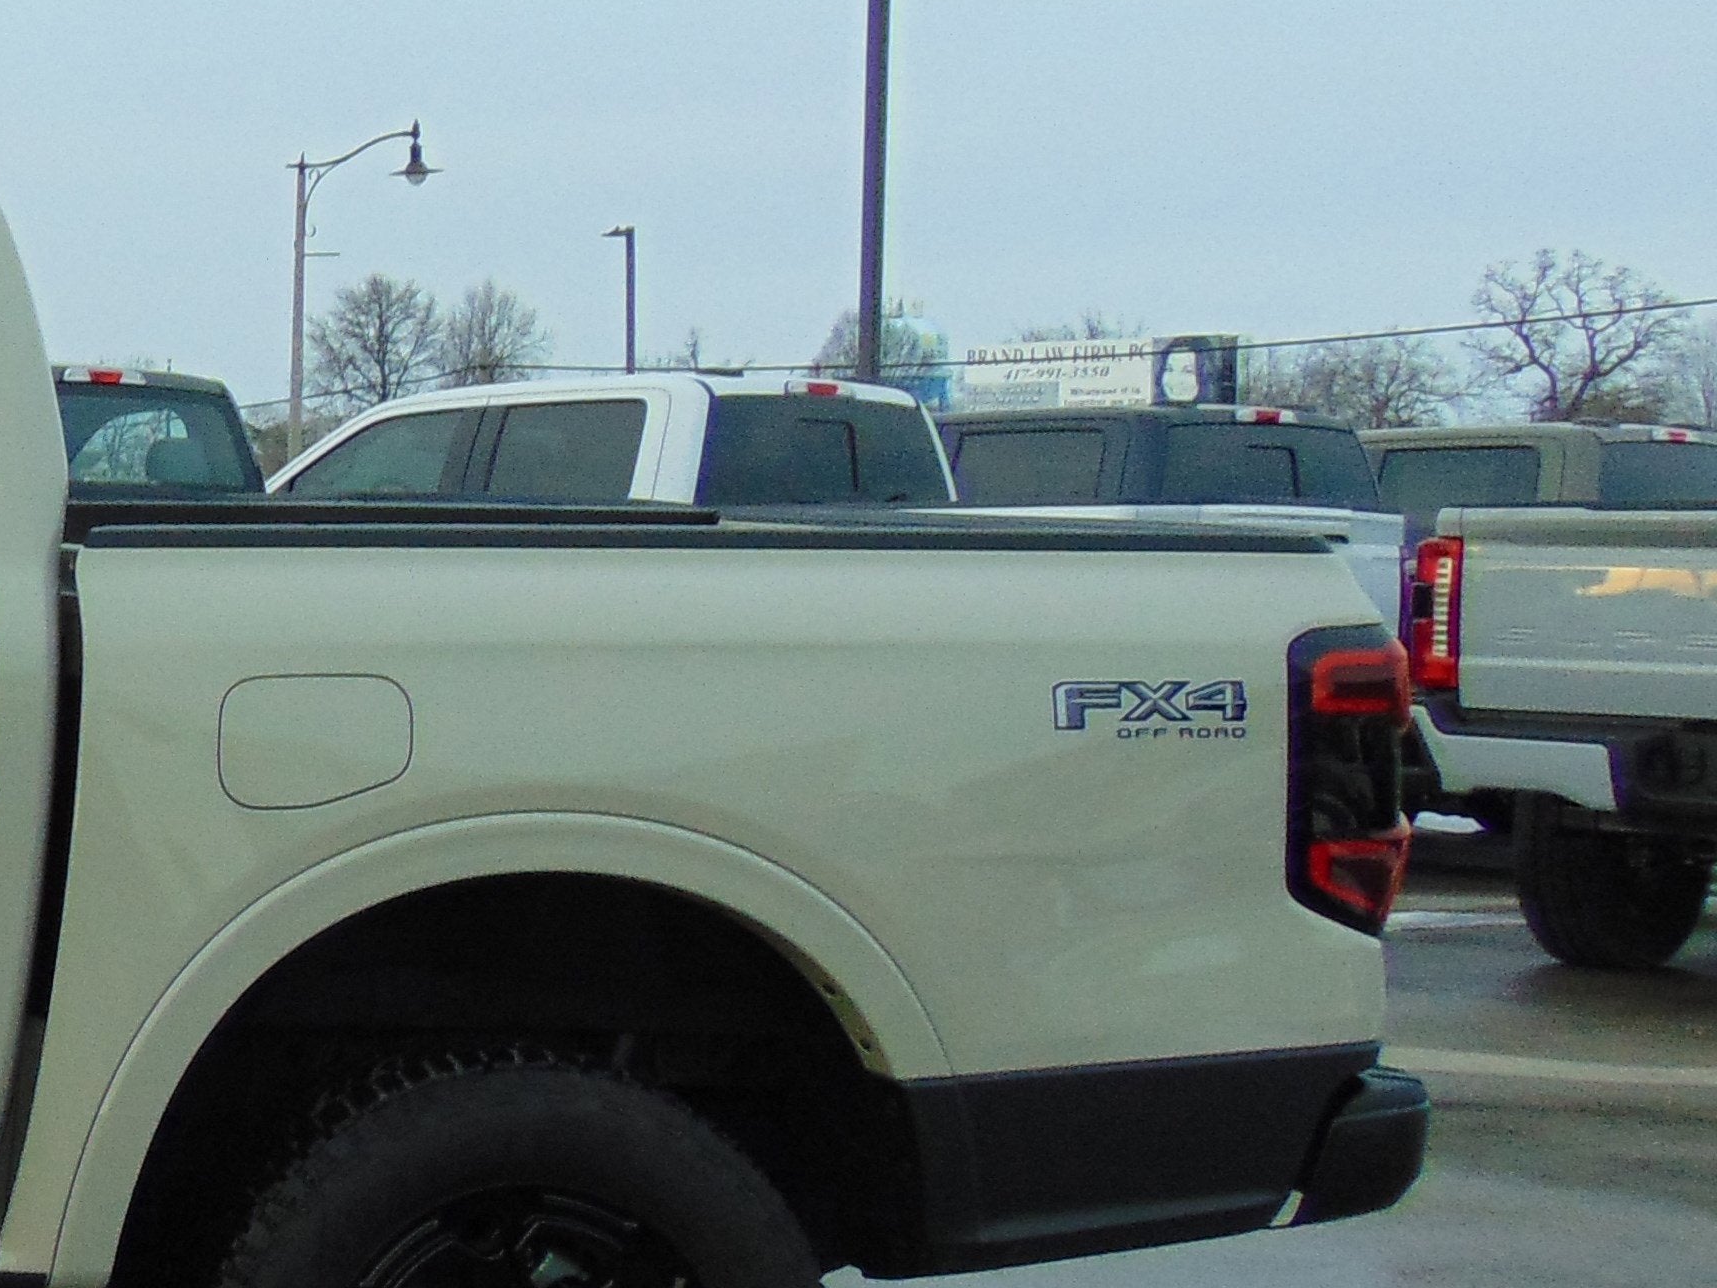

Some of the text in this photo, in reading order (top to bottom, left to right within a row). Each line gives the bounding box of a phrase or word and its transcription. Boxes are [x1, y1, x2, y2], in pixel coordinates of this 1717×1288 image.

[966, 348, 1025, 366] BRAND
[1030, 346, 1066, 364] LAW
[1052, 680, 1247, 730] FX4
[1116, 727, 1247, 739] OFF ROAD
